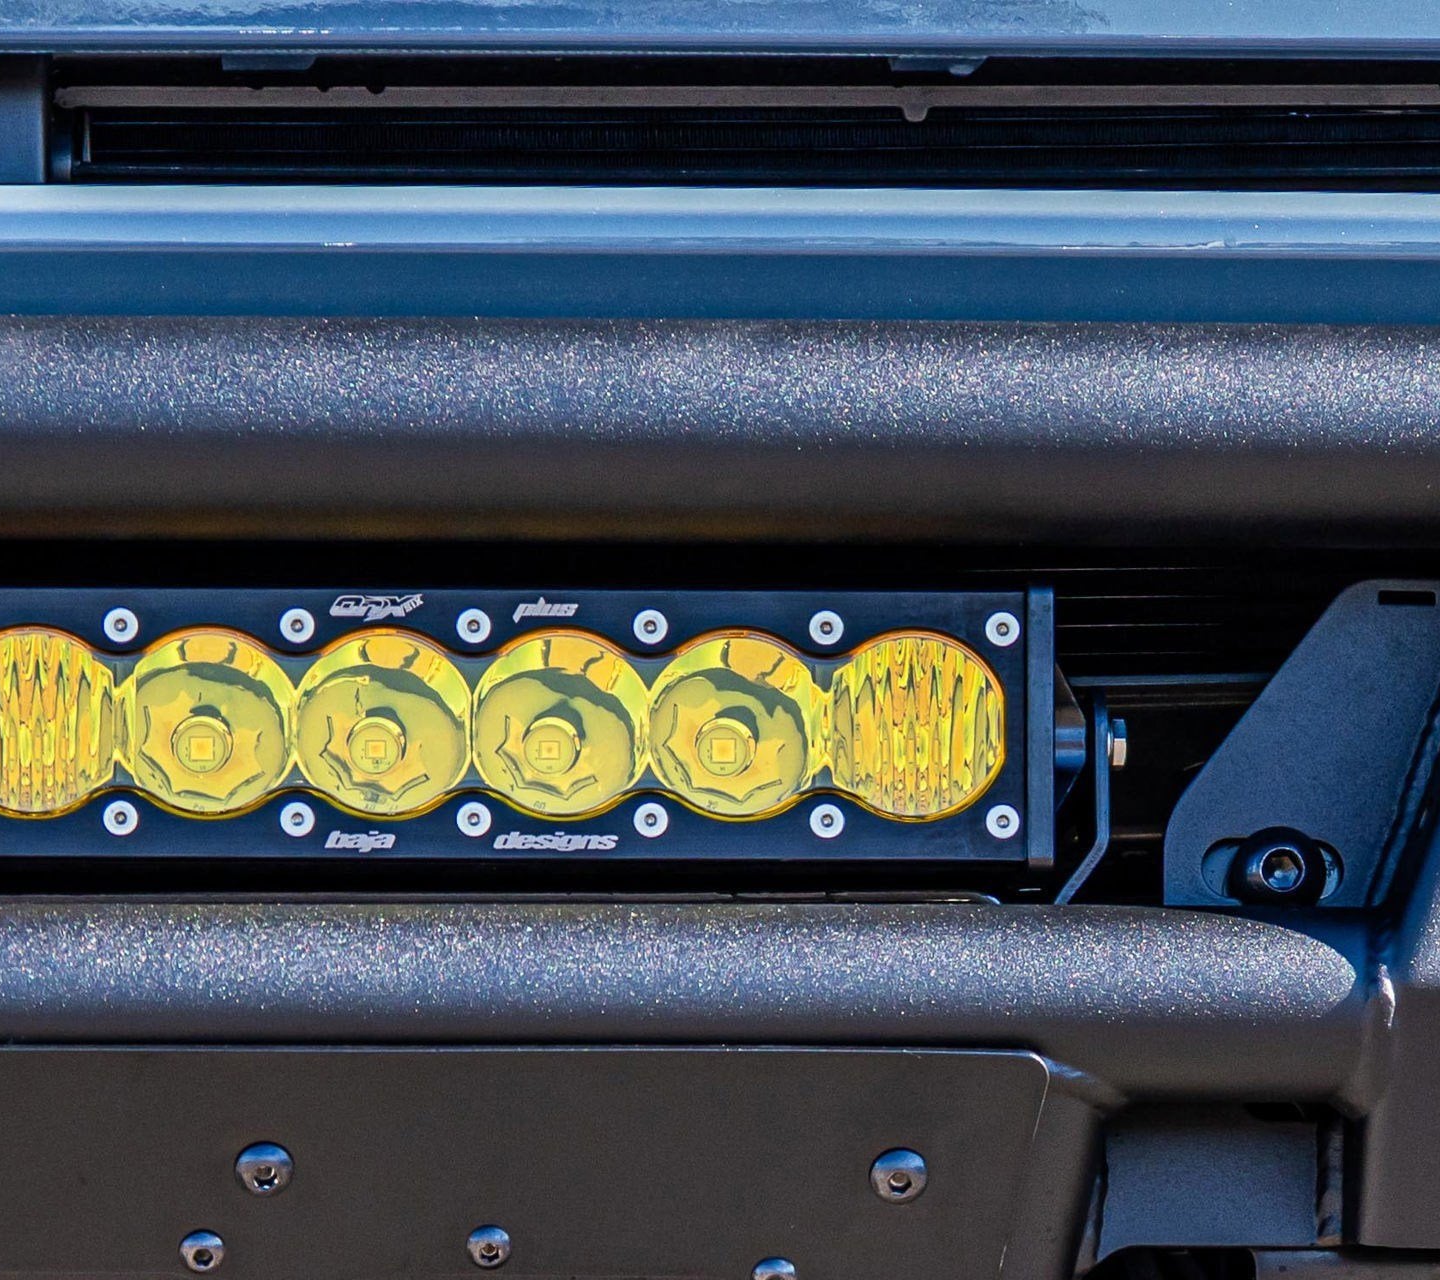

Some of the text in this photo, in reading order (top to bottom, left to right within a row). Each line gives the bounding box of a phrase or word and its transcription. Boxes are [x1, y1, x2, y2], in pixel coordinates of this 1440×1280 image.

[512, 596, 579, 624] plus
[324, 830, 619, 853] baja designs
